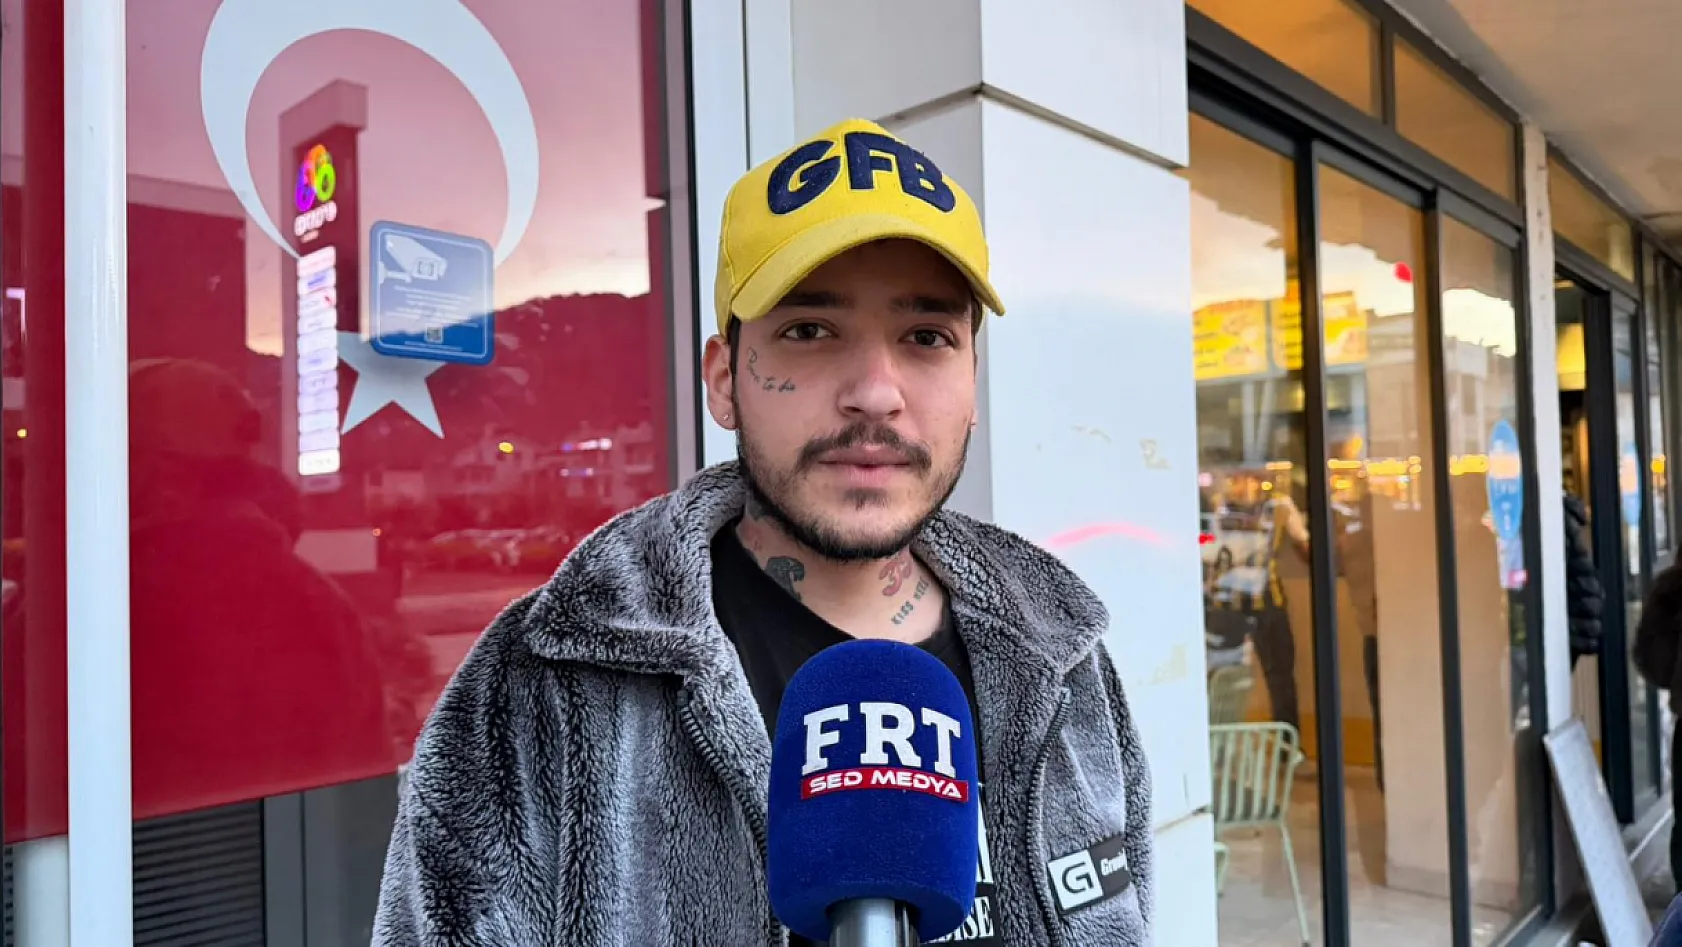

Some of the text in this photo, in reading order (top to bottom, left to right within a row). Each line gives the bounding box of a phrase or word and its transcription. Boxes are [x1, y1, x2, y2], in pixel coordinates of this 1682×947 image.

[768, 131, 956, 214] GFB
[802, 702, 961, 779] FRT
[810, 770, 962, 799] SED MEDYA
